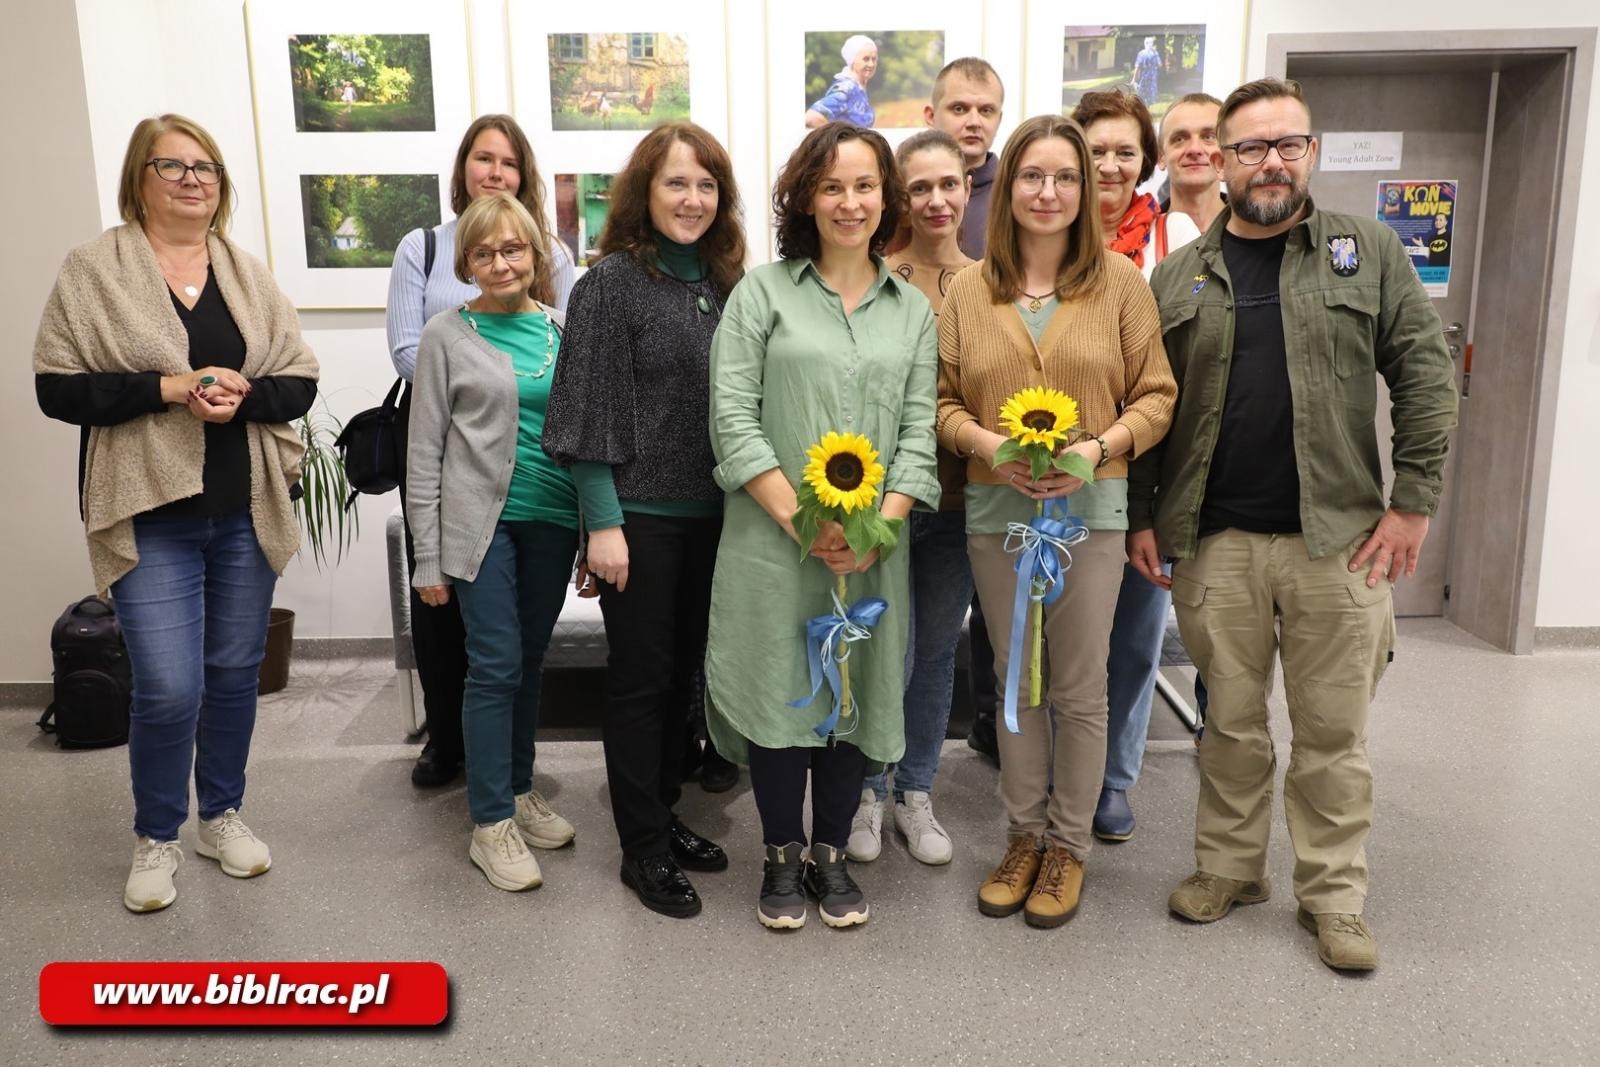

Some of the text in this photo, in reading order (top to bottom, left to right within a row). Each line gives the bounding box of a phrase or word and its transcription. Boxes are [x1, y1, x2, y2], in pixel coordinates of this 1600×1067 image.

[1328, 154, 1394, 164] Young Adult Zone
[1410, 201, 1453, 216] MOVIE
